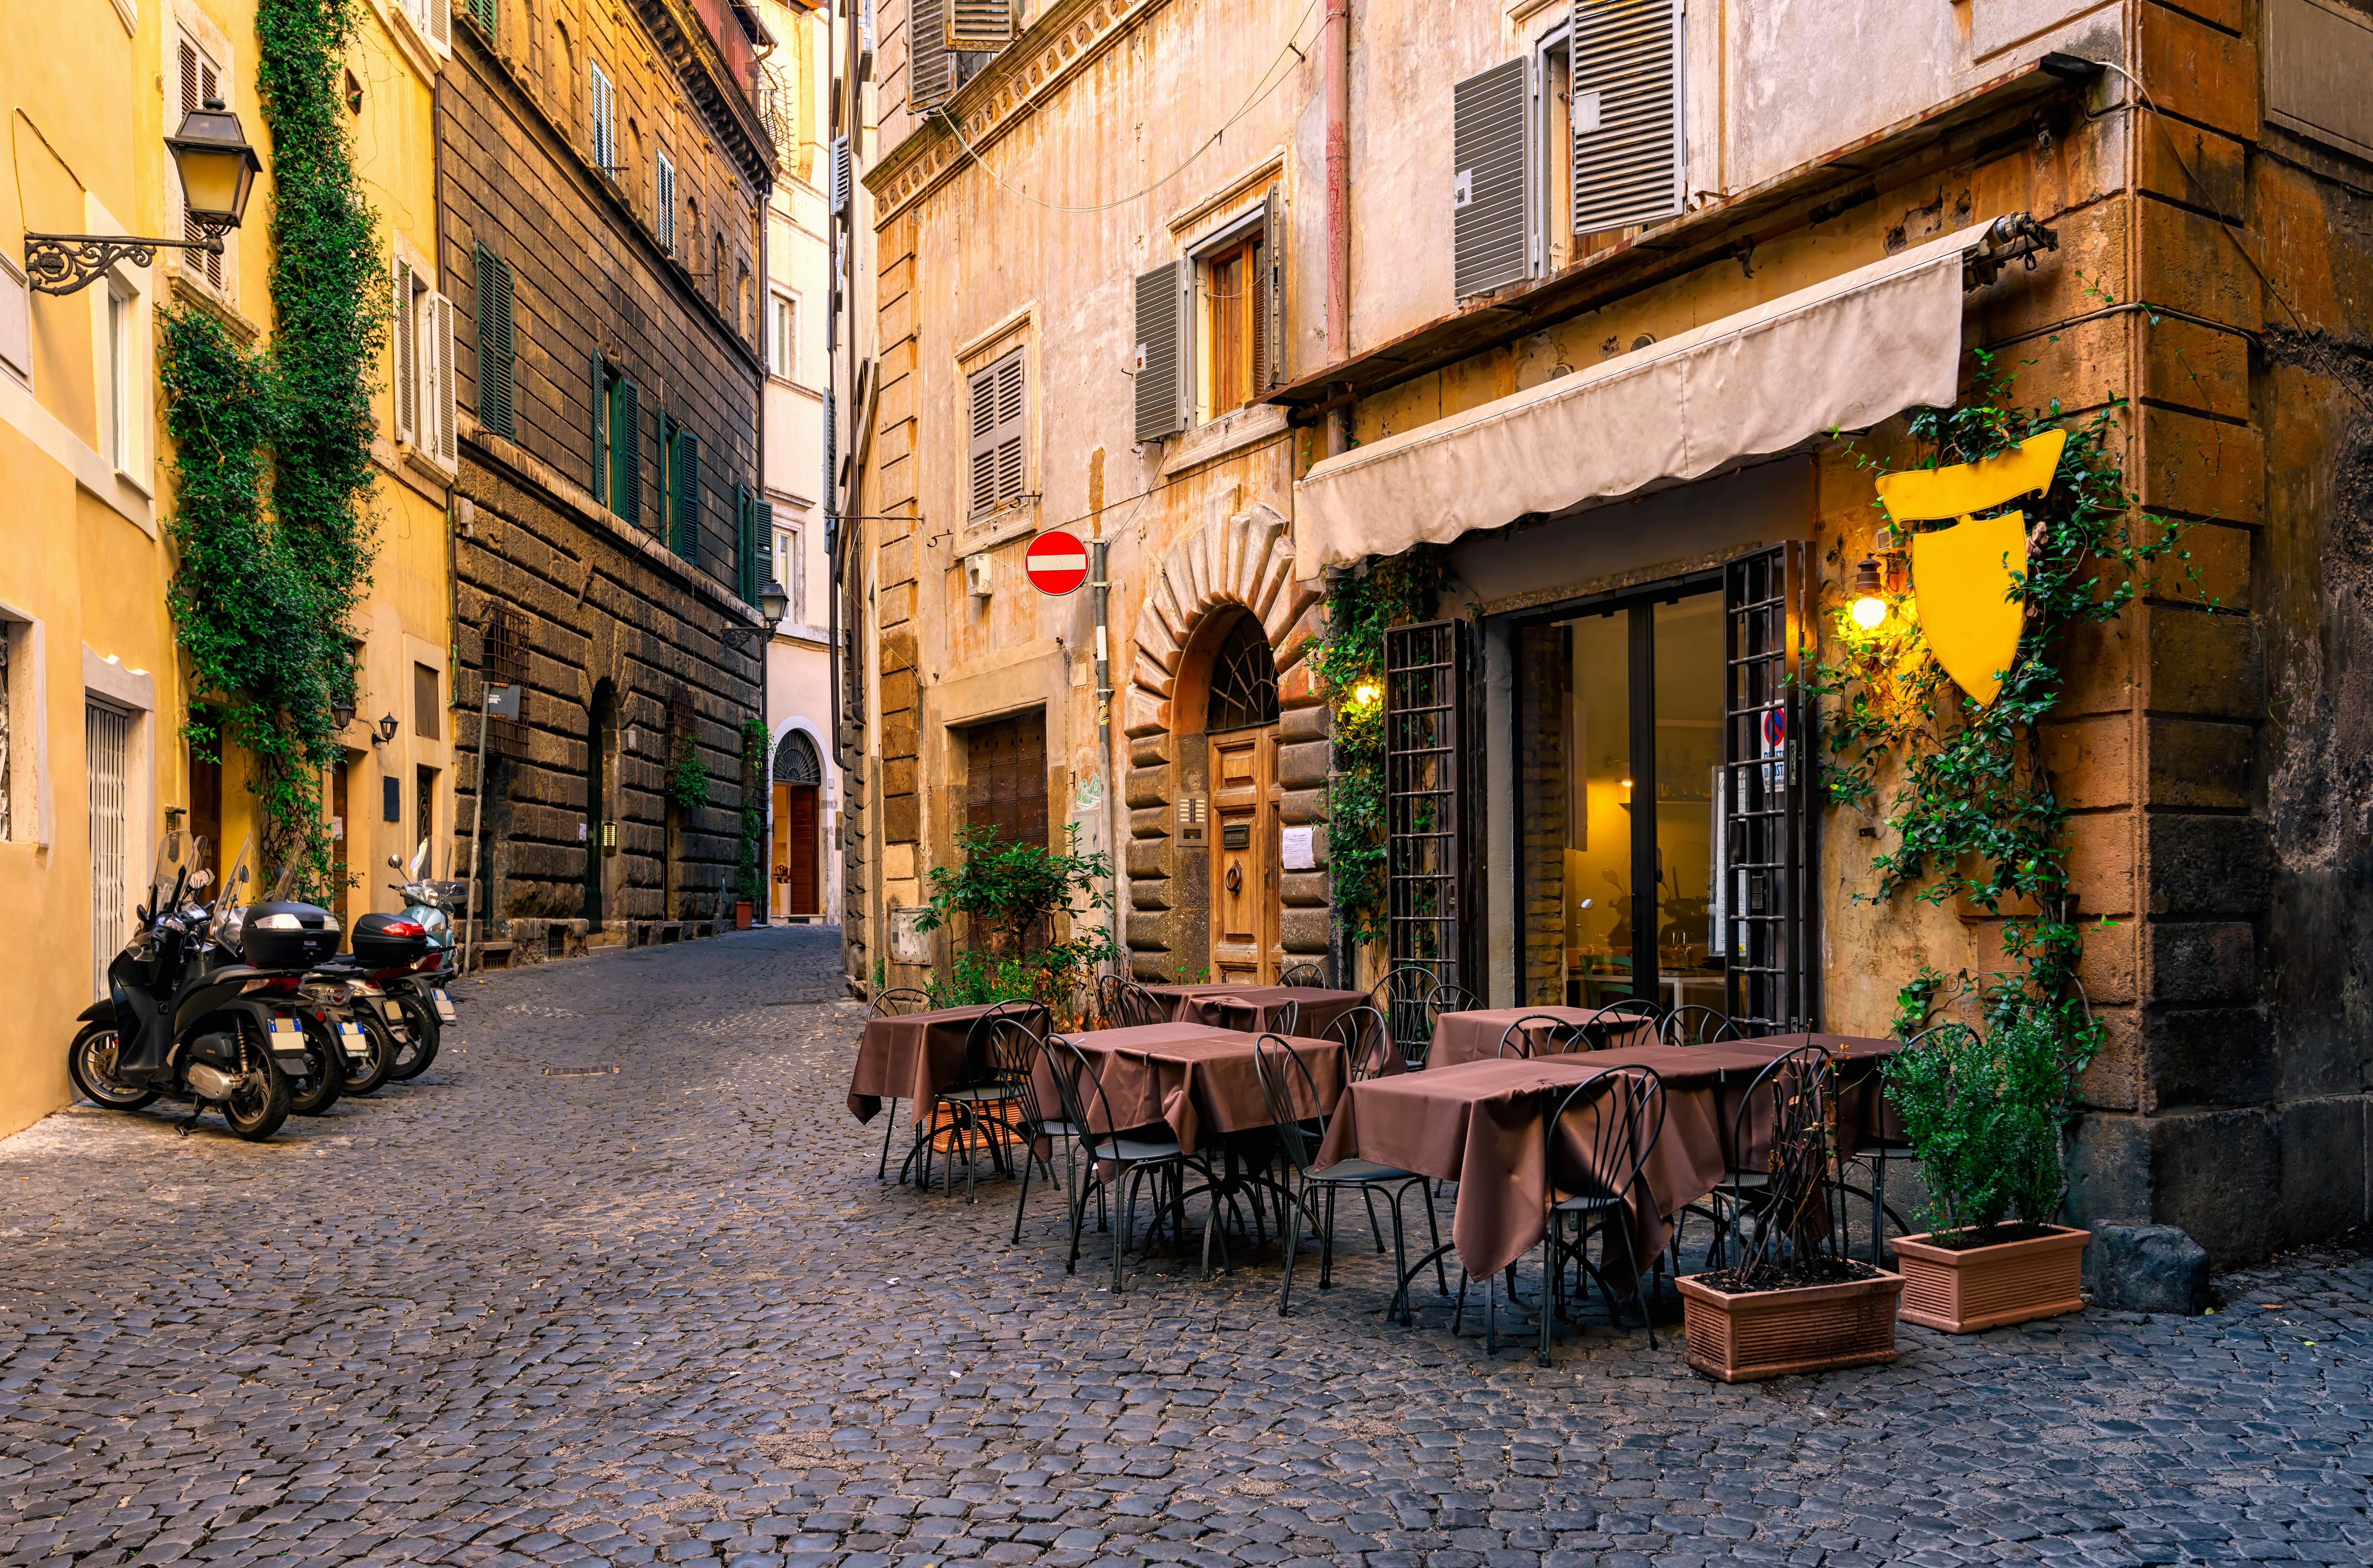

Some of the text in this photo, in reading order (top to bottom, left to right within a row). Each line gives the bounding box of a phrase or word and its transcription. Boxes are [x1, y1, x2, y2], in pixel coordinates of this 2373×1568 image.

[1764, 750, 1785, 758] DIET
[1764, 764, 1783, 778] DI OST
